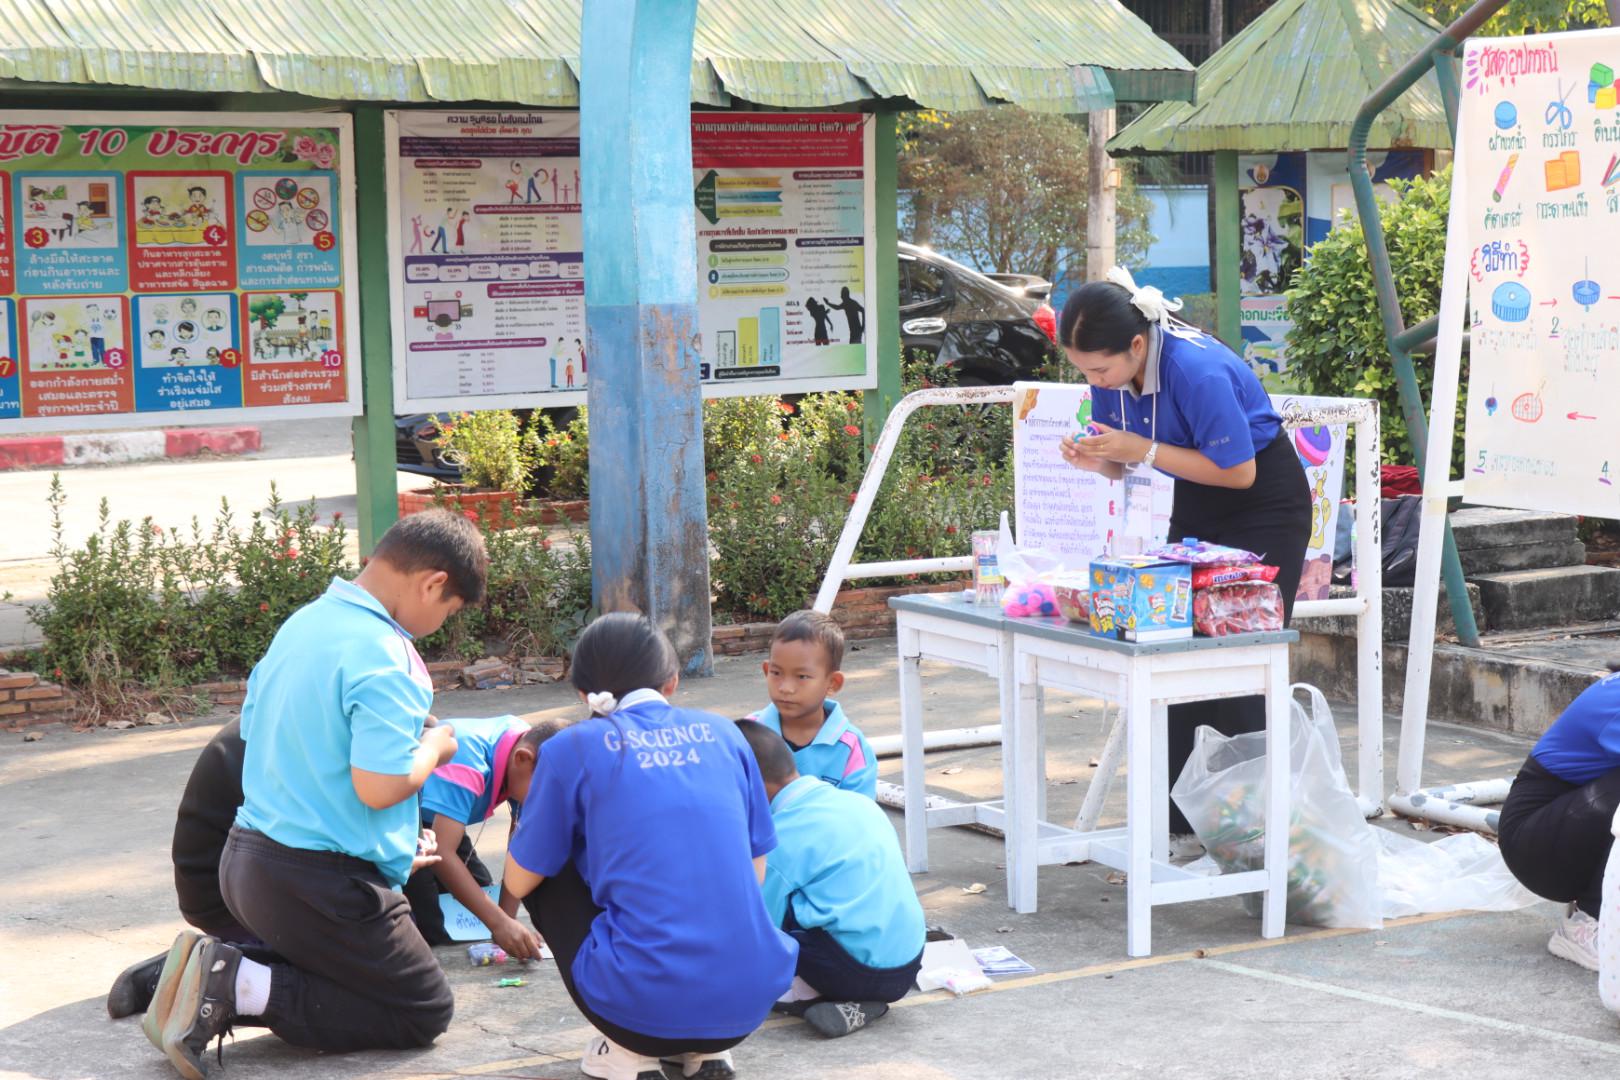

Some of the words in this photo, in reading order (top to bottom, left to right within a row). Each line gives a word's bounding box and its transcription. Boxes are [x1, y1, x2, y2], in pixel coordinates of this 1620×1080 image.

[80, 129, 128, 155] 10
[148, 129, 284, 164] ประการ
[32, 230, 44, 245] 3
[208, 227, 221, 242] 4
[319, 234, 331, 248] 5
[1550, 316, 1560, 334] 2
[109, 351, 122, 367] 8
[225, 351, 237, 366] 9
[323, 353, 342, 368] 10
[0, 359, 10, 376] 7
[1477, 450, 1488, 468] 5
[1601, 460, 1610, 479] 4
[637, 747, 701, 769] 2024
